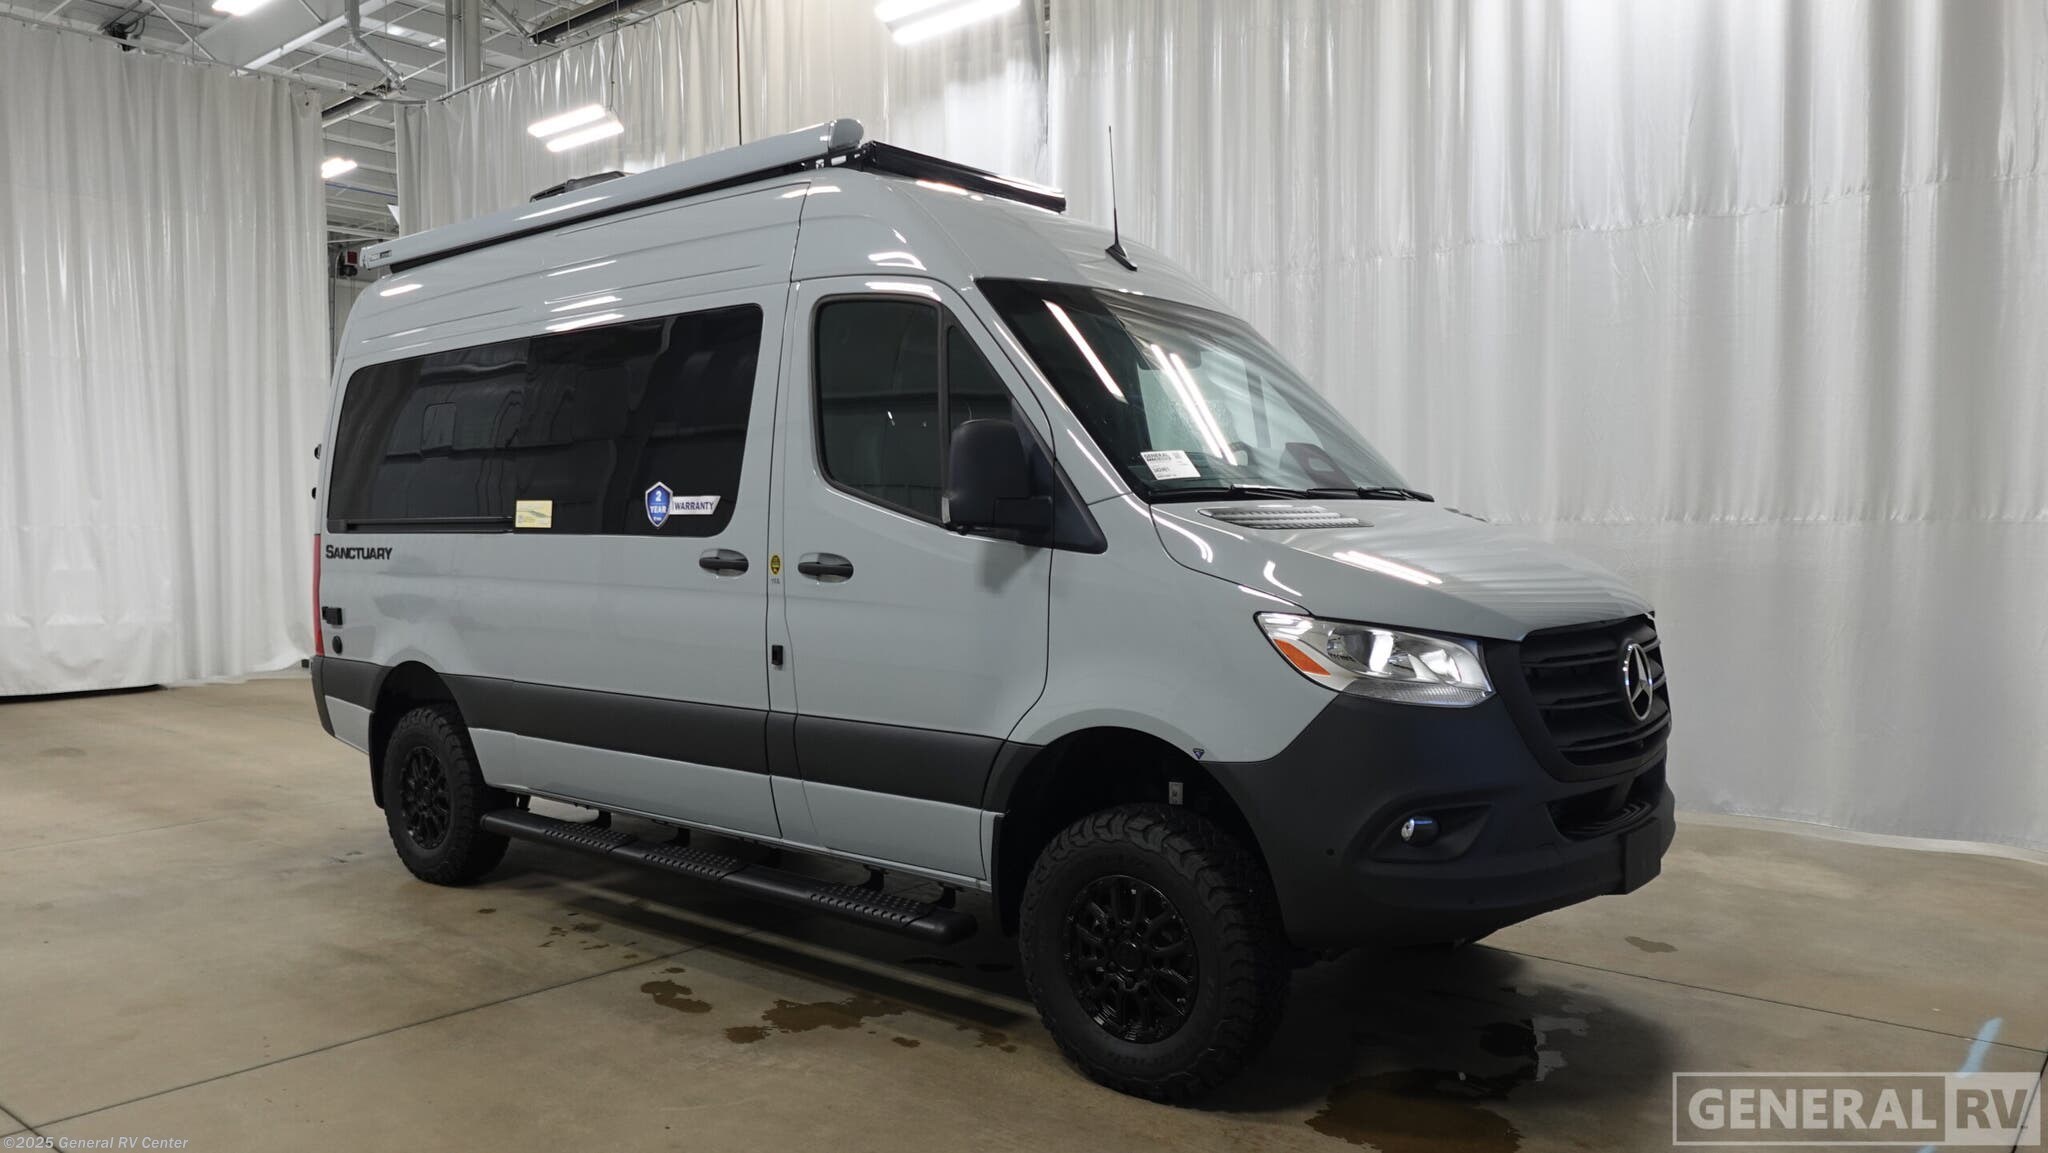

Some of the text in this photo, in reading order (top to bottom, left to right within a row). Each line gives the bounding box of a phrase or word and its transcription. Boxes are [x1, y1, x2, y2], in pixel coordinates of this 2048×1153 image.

[655, 490, 662, 502] 2
[650, 505, 667, 514] YEAR
[674, 501, 715, 511] WARRANTY
